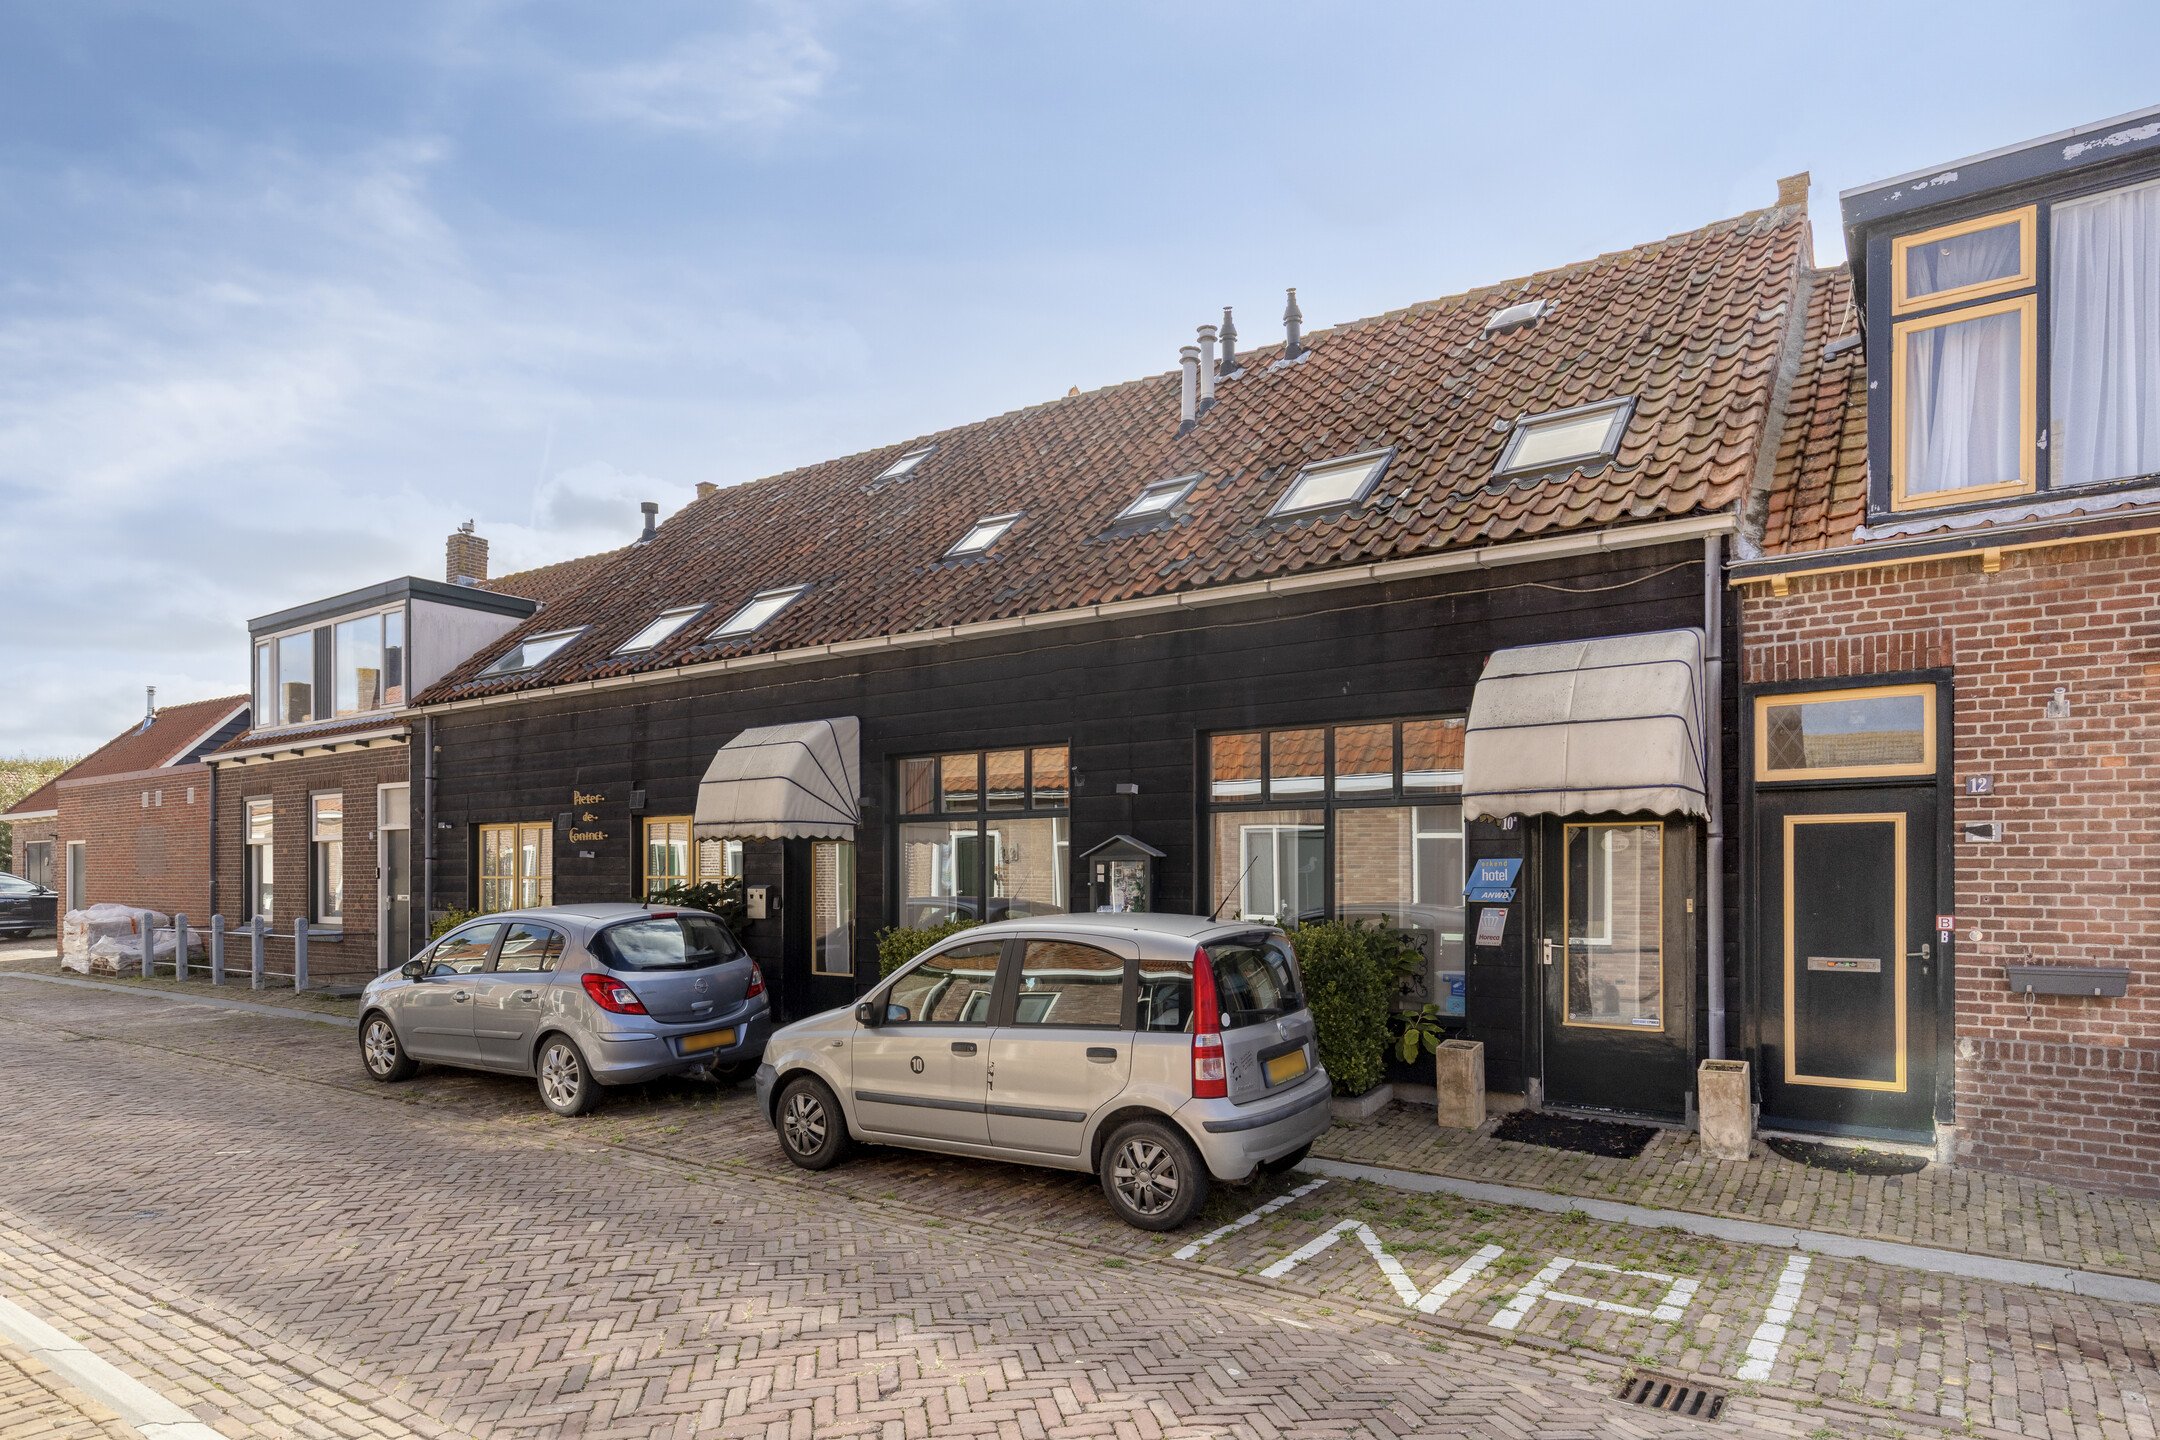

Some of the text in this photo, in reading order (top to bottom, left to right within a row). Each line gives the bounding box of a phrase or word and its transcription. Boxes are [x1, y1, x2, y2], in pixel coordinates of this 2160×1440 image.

[1970, 777, 1988, 793] 12
[1481, 868, 1508, 881] hotel
[1481, 891, 1509, 899] ANWB
[1941, 918, 1950, 928] B
[911, 1058, 923, 1073] 10
